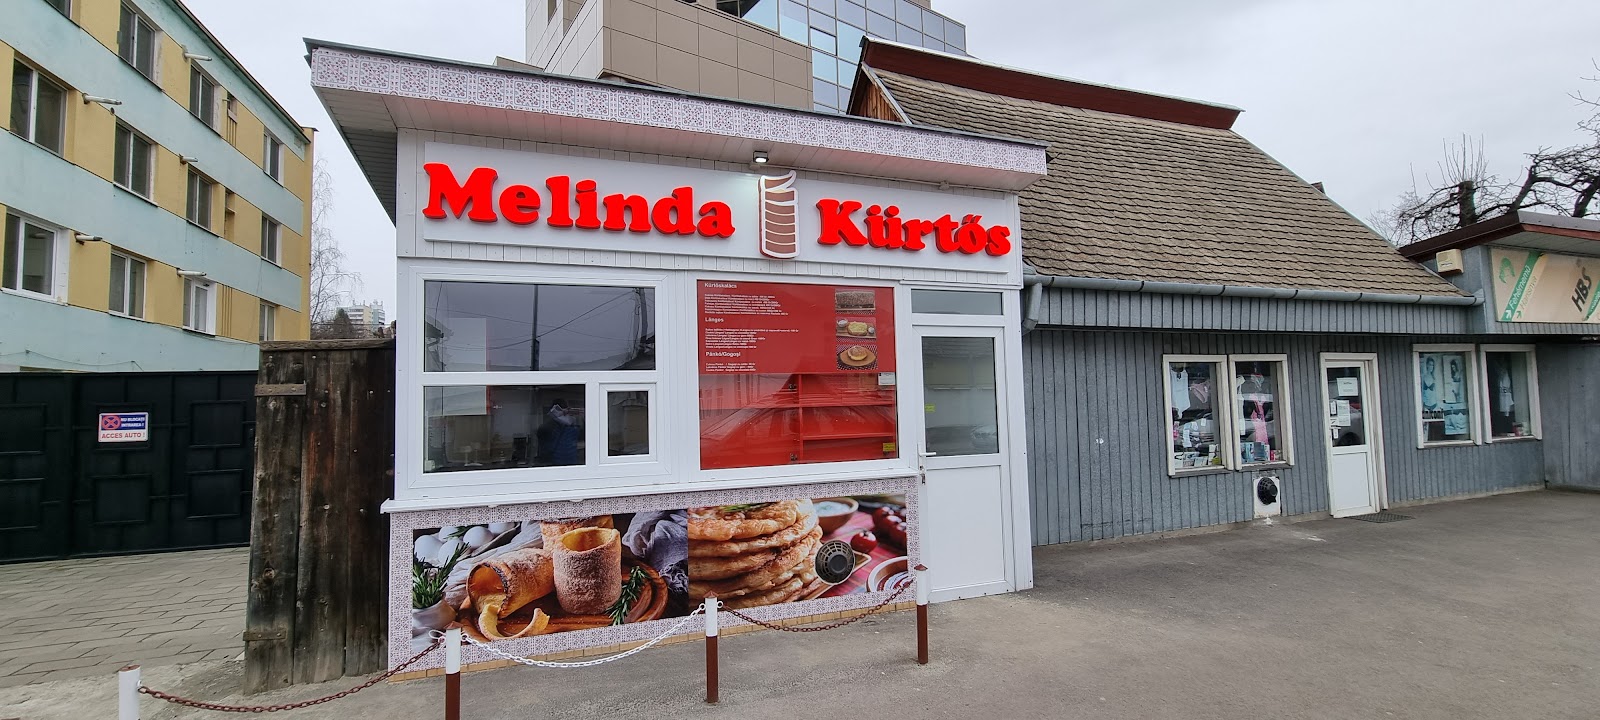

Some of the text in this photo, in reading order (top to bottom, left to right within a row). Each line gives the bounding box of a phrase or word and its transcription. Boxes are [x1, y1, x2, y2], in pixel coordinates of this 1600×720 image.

[422, 162, 1012, 257] Melinda Kürtős
[1571, 266, 1592, 312] HBS
